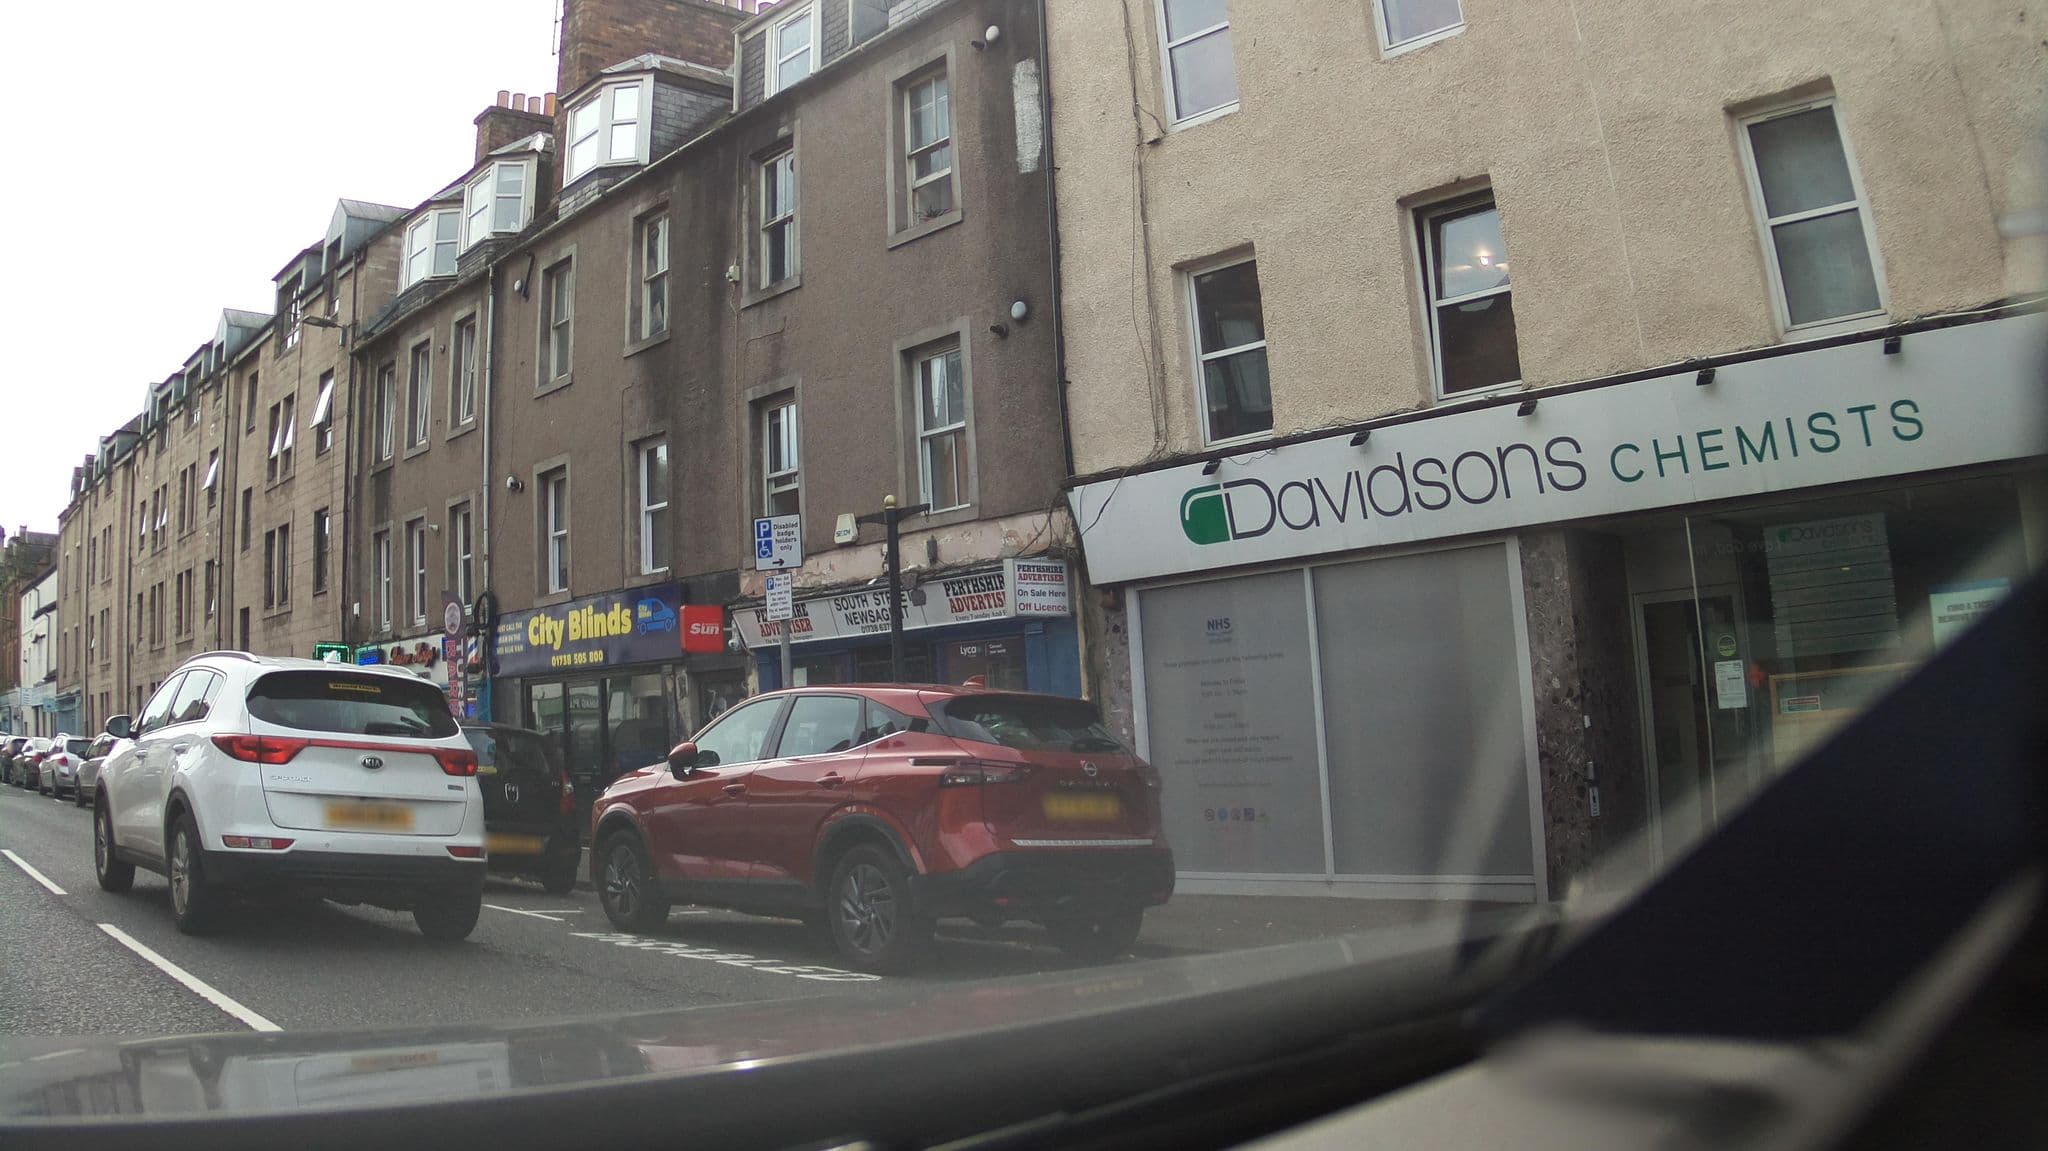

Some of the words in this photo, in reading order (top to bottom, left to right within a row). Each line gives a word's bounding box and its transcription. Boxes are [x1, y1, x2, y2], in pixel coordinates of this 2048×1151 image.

[1223, 436, 1588, 541] Davidsons
[1610, 399, 1925, 483] CHEMISTS
[773, 522, 799, 530] Disabled
[776, 529, 795, 538] badge
[775, 537, 797, 545] holders
[780, 544, 793, 552] only
[1017, 564, 1064, 574] PERTHSHIRE
[1018, 573, 1064, 582] ADVERTISER
[942, 573, 1005, 597] PERTHSHIR
[1017, 588, 1029, 597] On
[1030, 588, 1047, 597] Sale
[1048, 589, 1067, 598] Here
[833, 593, 869, 611] SOUTH
[872, 590, 913, 606] STRET
[948, 590, 1006, 613] ADVERTIS
[1018, 602, 1032, 611] Off
[1034, 602, 1067, 612] Licence
[844, 605, 909, 626] NEWSAGT
[528, 612, 565, 650] City
[568, 602, 632, 641] Blinds
[689, 621, 720, 635] Sun
[1206, 618, 1232, 631] NHS
[960, 645, 977, 656] Lyca
[551, 653, 572, 667] 01738
[574, 651, 586, 664] 505
[589, 649, 604, 663] 800
